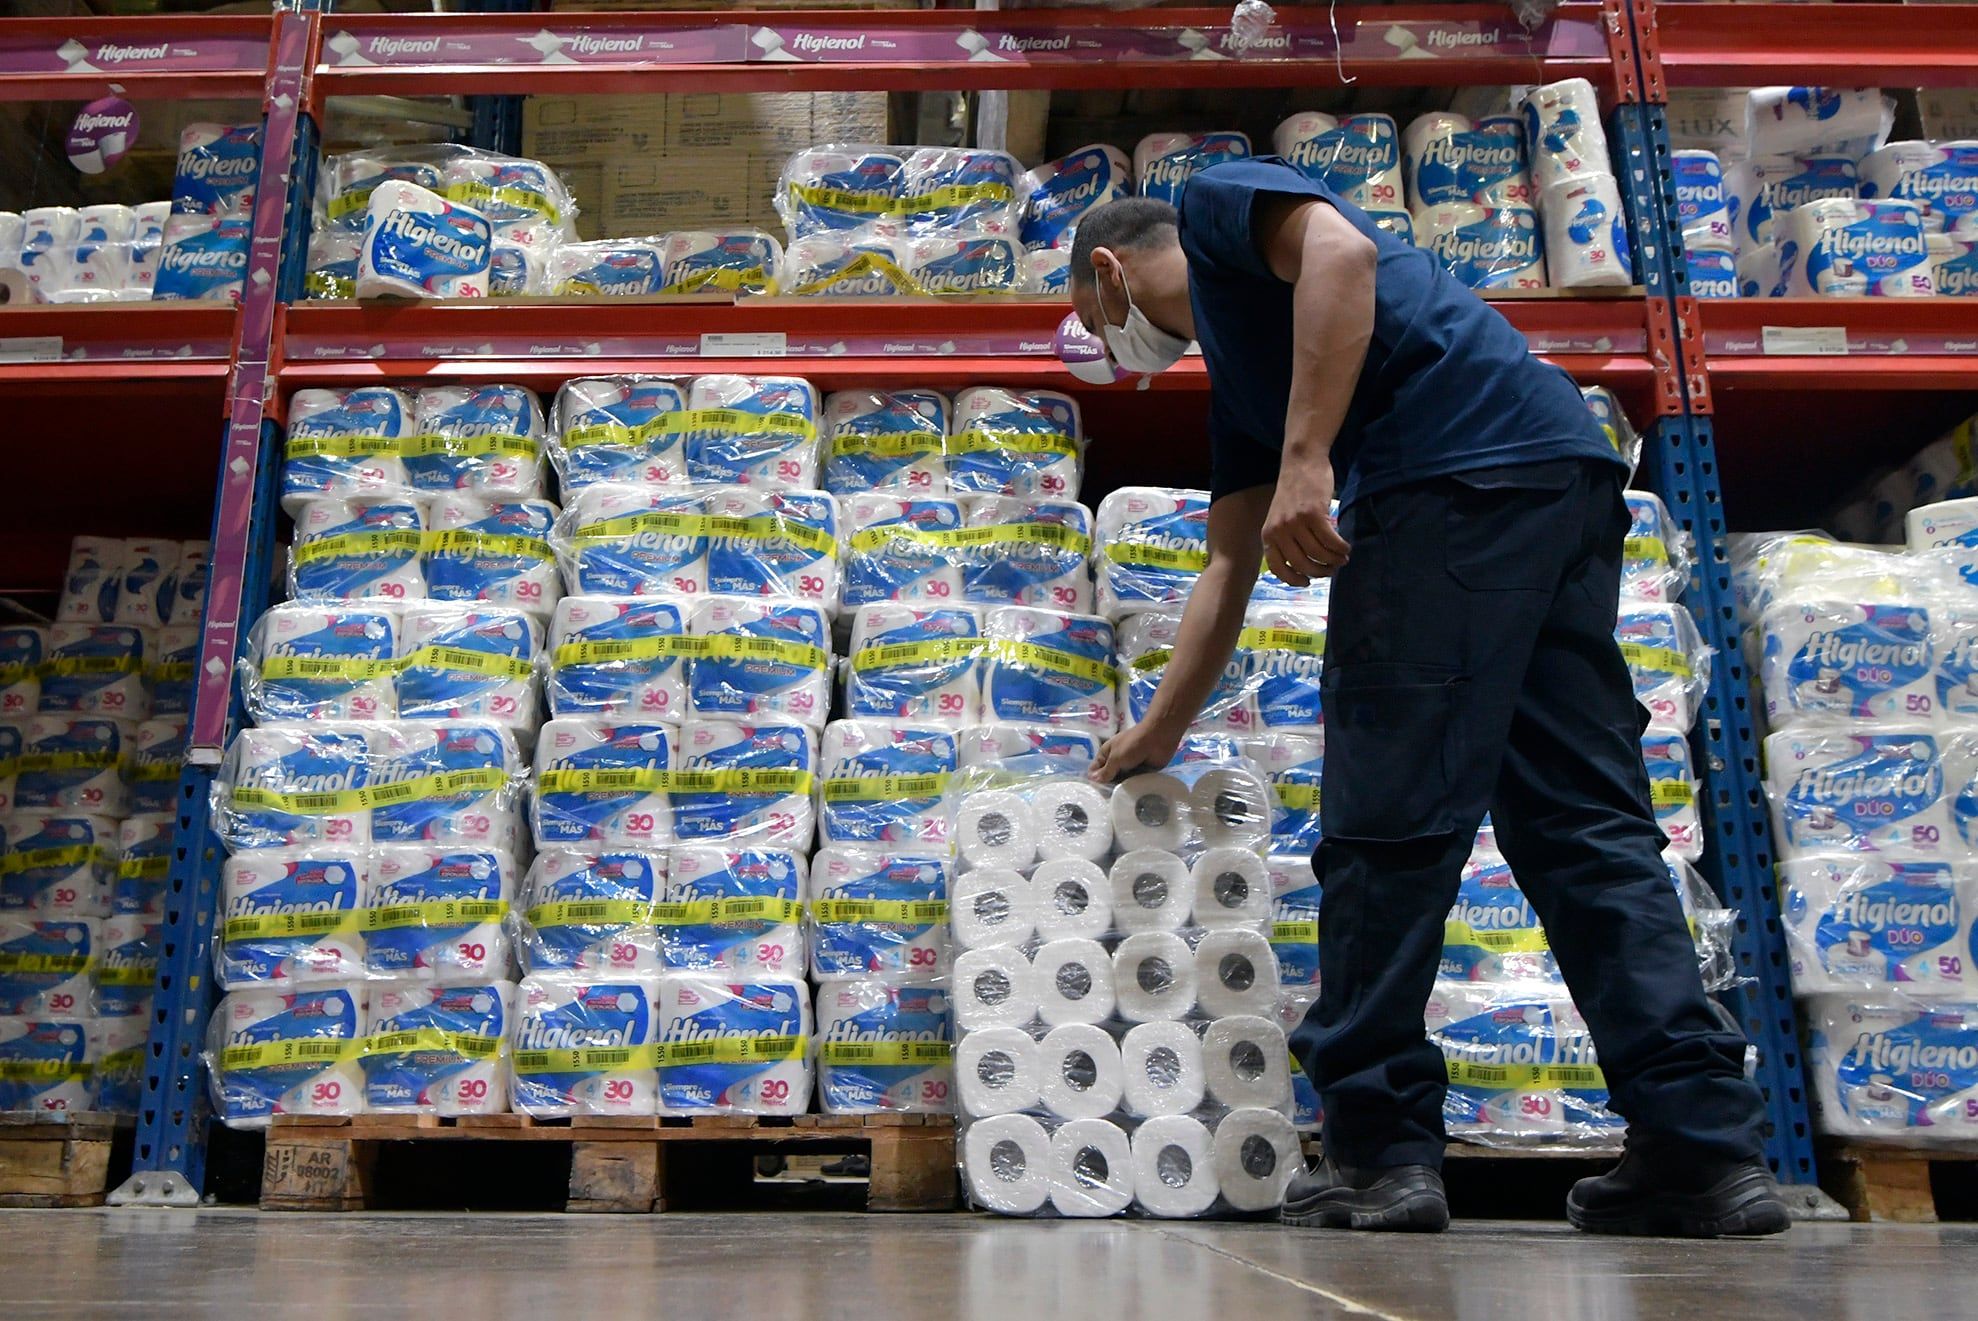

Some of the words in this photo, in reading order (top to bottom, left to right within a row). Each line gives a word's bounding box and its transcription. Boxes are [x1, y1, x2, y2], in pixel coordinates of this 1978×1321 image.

[369, 36, 441, 53] Higienol
[571, 35, 644, 52] Higienol
[794, 33, 865, 51] Higienol
[999, 35, 1071, 52] Higienol
[1428, 30, 1499, 46] Higienol
[97, 43, 169, 63] Higienol
[74, 112, 133, 132] Higienol
[177, 151, 256, 179] Higieno
[1290, 140, 1392, 173] Higienol
[1425, 140, 1523, 173] Higienol
[1565, 158, 1581, 170] 30
[1371, 184, 1396, 199] 30
[1507, 184, 1529, 199] 30
[1900, 170, 1978, 200] Higien
[384, 210, 483, 264] Higienol
[1711, 221, 1729, 236] 50
[1432, 232, 1536, 263] Higienol
[1590, 249, 1606, 261] 30
[1821, 229, 1924, 264] Higienol
[159, 244, 247, 273] Higieno
[459, 282, 481, 297] 30
[776, 460, 801, 478] 30
[910, 471, 932, 486] 30
[380, 583, 405, 598] 30
[449, 585, 472, 597] MÁS
[516, 580, 542, 597] 30
[674, 577, 697, 594] 30
[732, 580, 756, 591] MÁS
[798, 575, 824, 593] 30
[926, 580, 950, 598] 30
[1052, 587, 1077, 603] 30
[658, 638, 666, 651] 1550
[1259, 630, 1267, 646] 1550
[431, 648, 439, 664] 1550
[580, 644, 588, 659] 1550
[868, 649, 876, 665] 1550
[1807, 631, 1928, 672] Higienol
[744, 665, 796, 676] PREMIUM
[1856, 666, 1893, 683] DÚO
[4, 695, 24, 707] 30
[103, 692, 125, 705] 30
[489, 695, 516, 714] 30
[641, 688, 669, 706] 30
[790, 690, 814, 708] 30
[872, 699, 894, 710] MÁS
[938, 694, 964, 712] 30
[1905, 694, 1932, 712] 50
[1022, 703, 1045, 715] MÁS
[1088, 704, 1110, 721] 30
[1227, 706, 1250, 724] 30
[1287, 708, 1313, 718] MÁS
[661, 772, 669, 788] 1550
[1799, 768, 1935, 802] Higienol
[83, 788, 104, 801] 30
[360, 790, 368, 806] 1550
[1854, 802, 1895, 817] DÚO
[326, 819, 353, 836] 30
[560, 822, 583, 834] MÁS
[625, 814, 655, 832] 30
[700, 820, 723, 832] MÁS
[767, 812, 795, 830] 30
[1912, 825, 1940, 843] 50
[54, 888, 76, 903] 30
[446, 902, 454, 918] 1550
[711, 902, 719, 918] 1550
[1833, 891, 1956, 933] Higienol
[287, 915, 295, 932] 1550
[369, 910, 377, 928] 1550
[1887, 929, 1924, 945] DÚO
[385, 950, 408, 962] MÁS
[458, 943, 485, 960] 30
[610, 943, 638, 962] 30
[756, 944, 784, 962] 30
[836, 954, 863, 965] MÁS
[909, 948, 937, 966] 30
[243, 962, 267, 973] MÁS
[1938, 956, 1962, 975] 50
[49, 993, 75, 1008] 30
[519, 1016, 634, 1048] Higienol
[285, 1042, 293, 1059] 1550
[657, 1045, 665, 1064] 1550
[740, 1039, 748, 1057] 1550
[1855, 1032, 1978, 1074] Higieno
[415, 1055, 465, 1065] PREMIUM
[572, 1050, 580, 1068] 1550
[1451, 1062, 1460, 1079] 1550
[1911, 1071, 1950, 1088] DÚO
[311, 1081, 341, 1100] 30
[386, 1087, 411, 1098] MÁS
[458, 1080, 487, 1098] 30
[604, 1080, 634, 1098] 30
[685, 1088, 711, 1100] MÁS
[760, 1079, 789, 1098] 30
[848, 1089, 873, 1101] MÁS
[901, 1084, 913, 1097] 4
[921, 1080, 947, 1098] 30
[242, 1099, 265, 1110] MÁS
[1521, 1096, 1551, 1115] 30
[307, 1151, 332, 1165] AR
